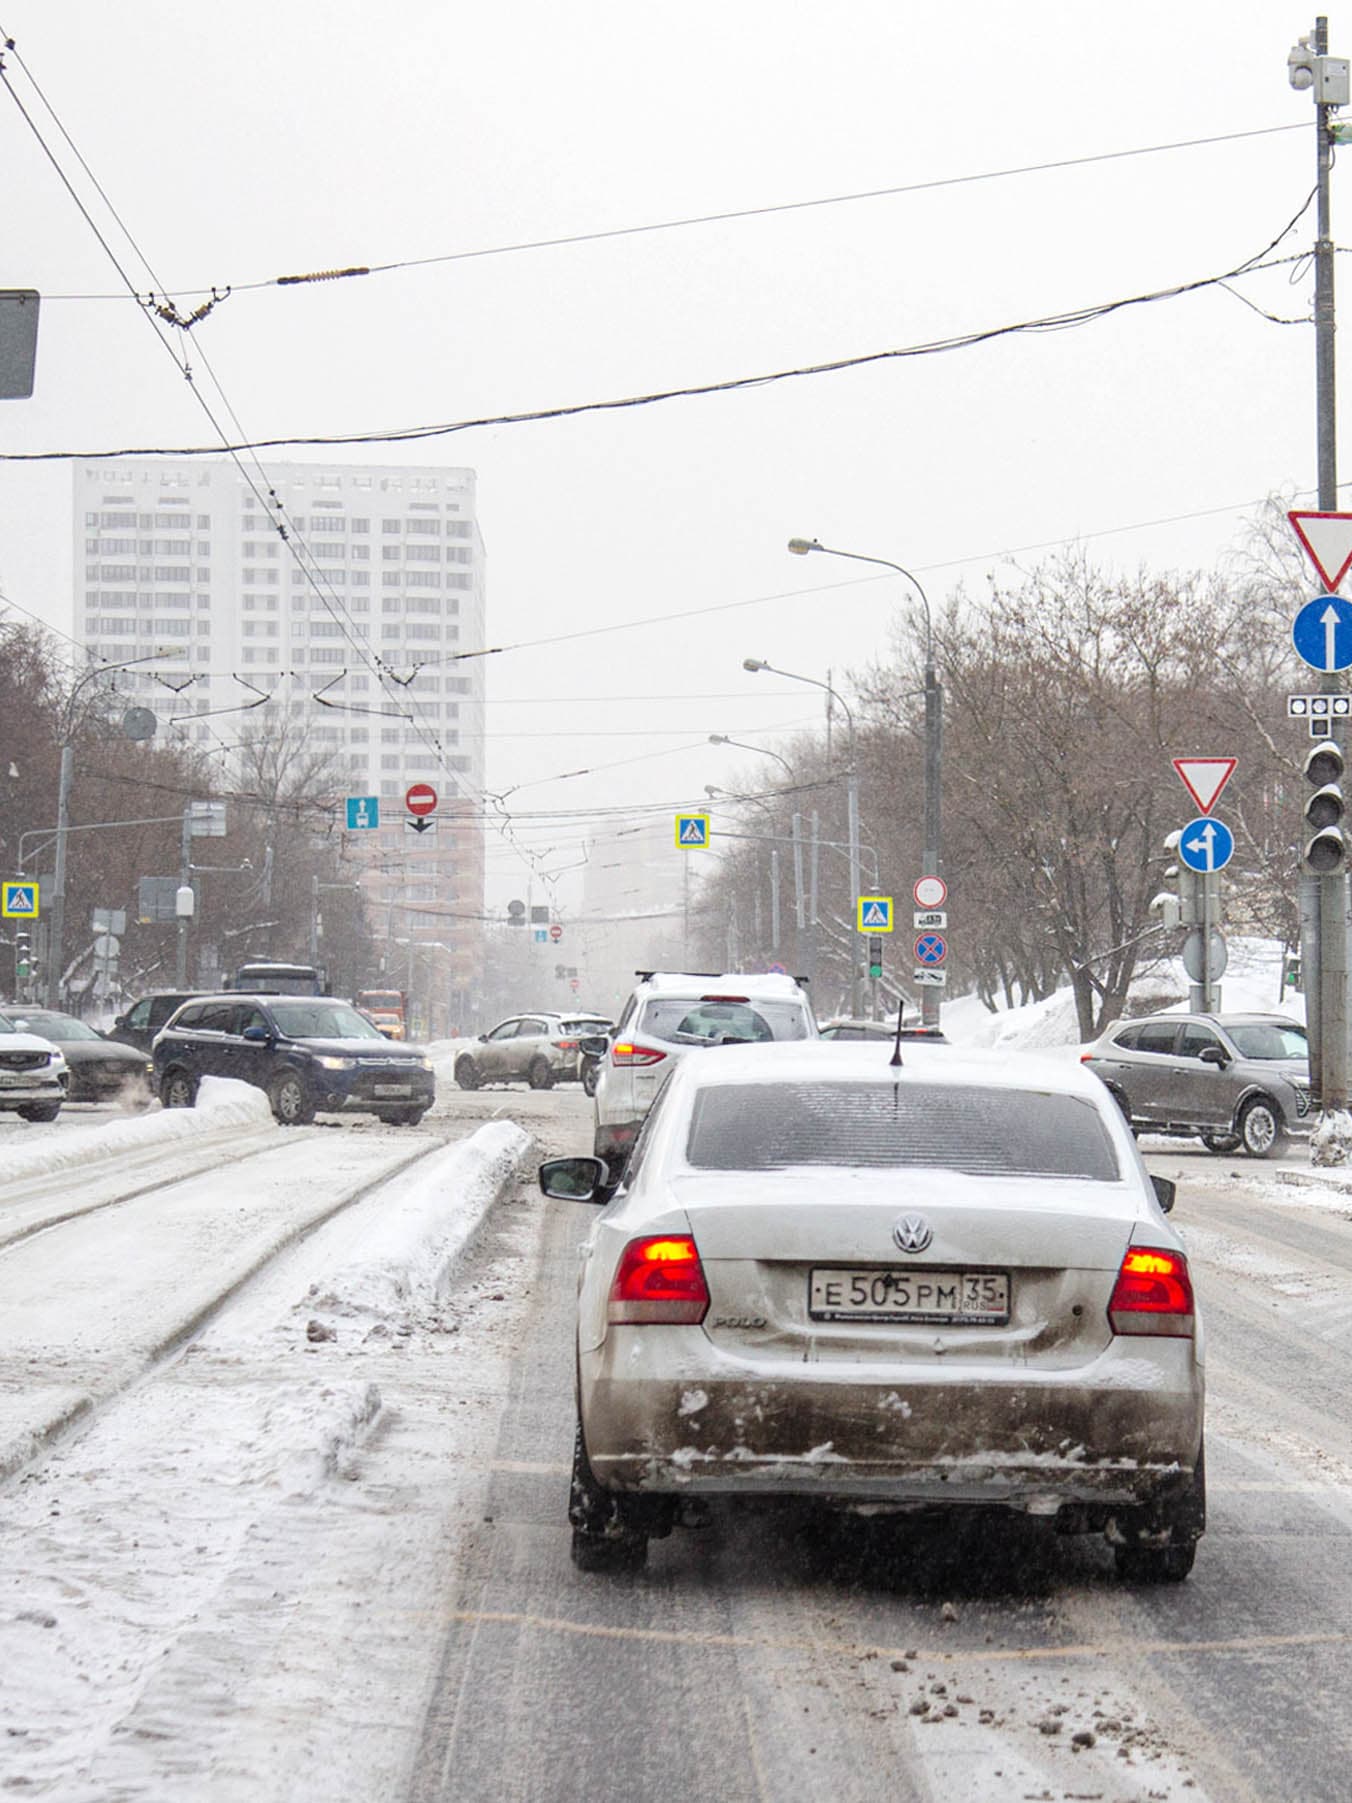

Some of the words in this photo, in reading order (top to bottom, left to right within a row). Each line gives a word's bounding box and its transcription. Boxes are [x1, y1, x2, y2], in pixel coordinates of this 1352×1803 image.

[965, 1277, 997, 1302] 35
[964, 1301, 986, 1311] RUS
[713, 1315, 767, 1328] POLO
